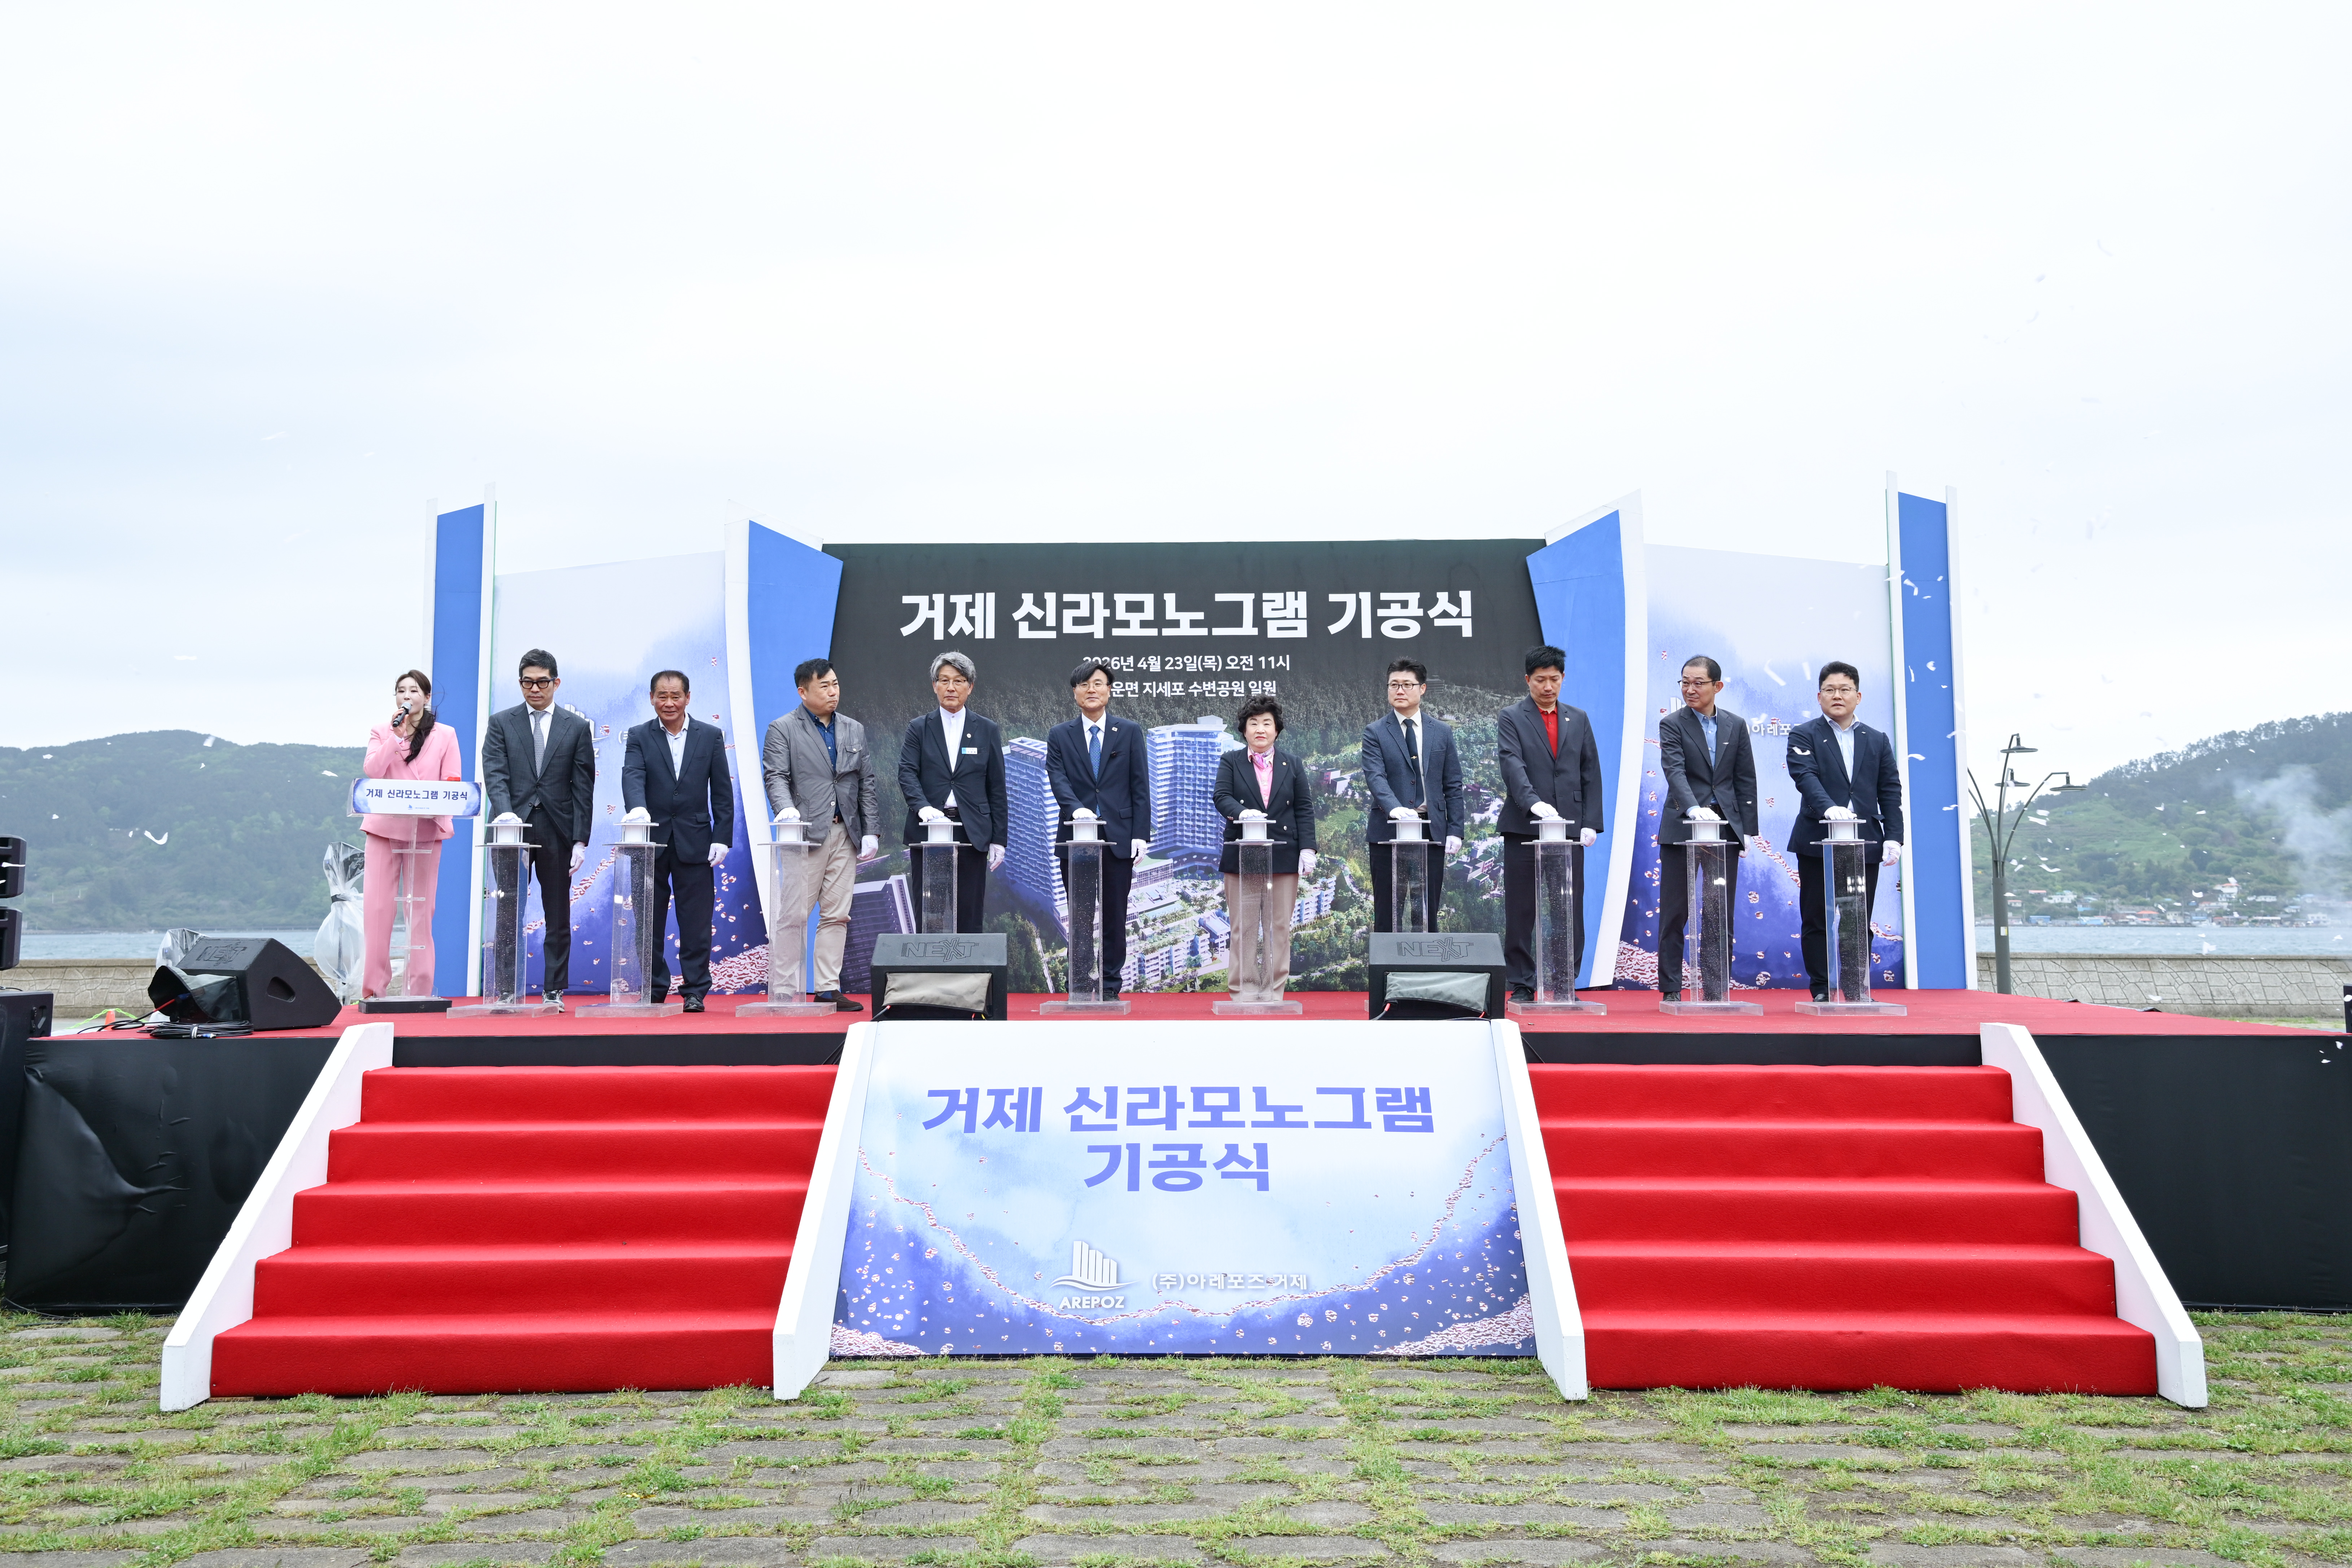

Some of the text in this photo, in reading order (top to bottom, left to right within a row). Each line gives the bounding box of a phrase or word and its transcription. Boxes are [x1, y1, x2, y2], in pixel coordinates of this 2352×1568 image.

[900, 591, 1472, 640] 거제 신라모노그램 기공식
[1137, 656, 1161, 672] 4월
[1165, 655, 1222, 672] 23일(목)
[1225, 655, 1253, 671] 오전
[1258, 655, 1290, 671] 11시
[1109, 681, 1276, 697] 운면 지세포 수변공원 일원
[366, 789, 467, 800] 거제 신라모노그램 기공식
[196, 942, 247, 966] NEXT
[902, 938, 979, 962] NEXT
[1397, 937, 1474, 961] NEXT
[922, 1086, 1434, 1134] 거제 신라모노그램
[1084, 1143, 1269, 1192] 기공식
[1152, 1273, 1307, 1290] (주)아레포즈 거제
[1059, 1296, 1124, 1309] AREPOZ
